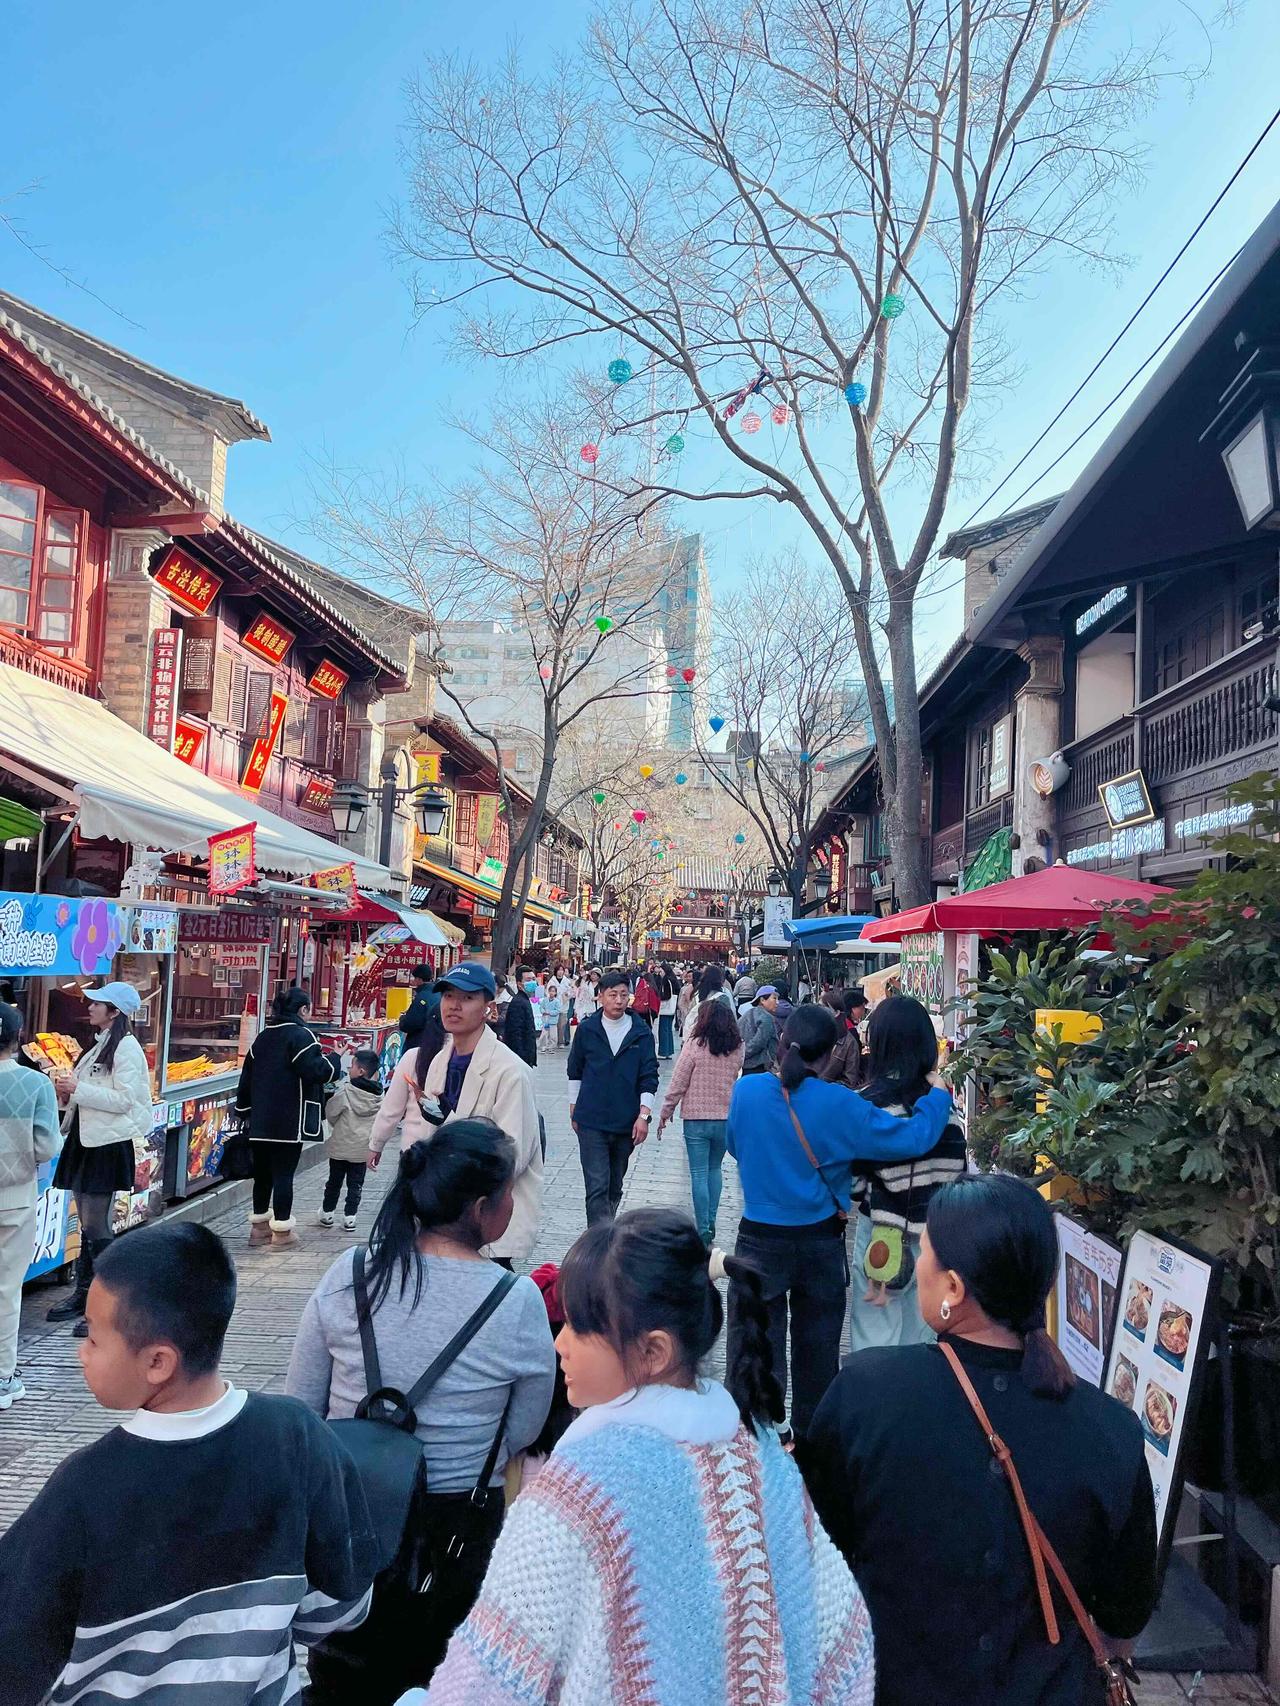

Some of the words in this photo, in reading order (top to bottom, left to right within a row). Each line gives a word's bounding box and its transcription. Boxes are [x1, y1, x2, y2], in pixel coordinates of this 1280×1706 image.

[165, 561, 213, 601] 古法传承
[0, 933, 55, 965] 南的生活
